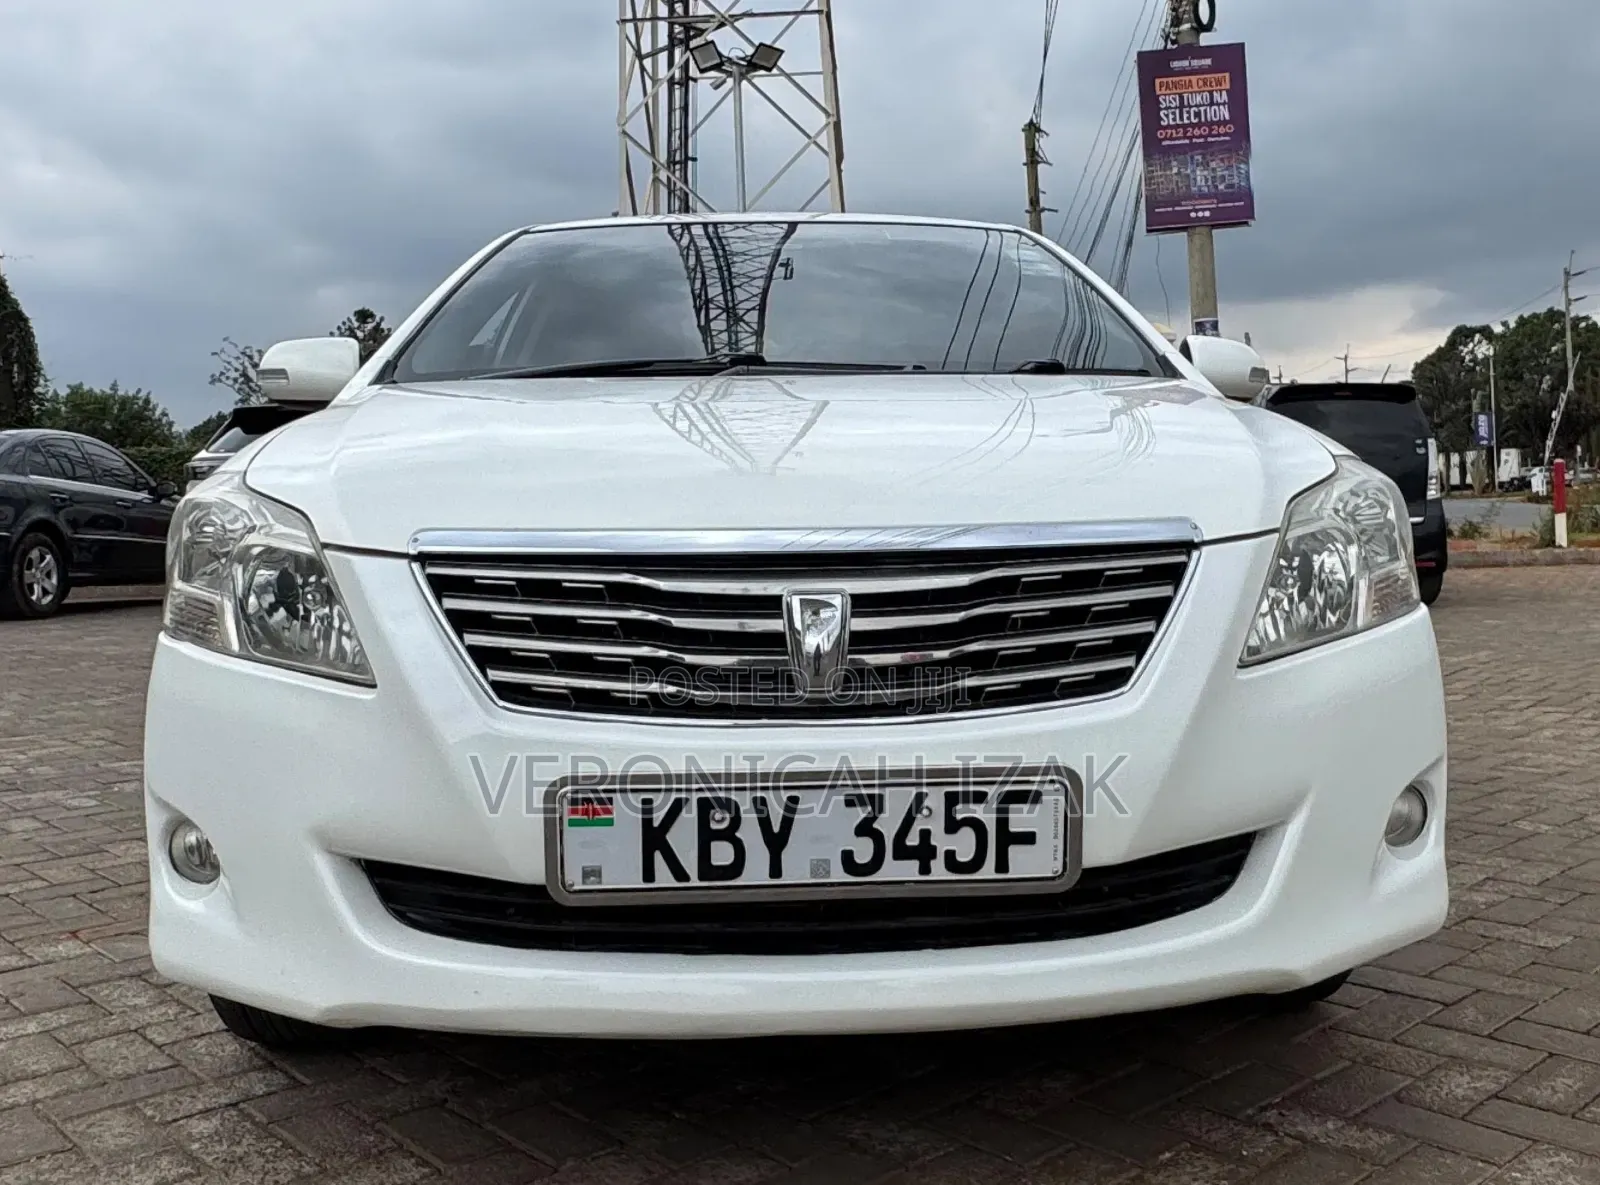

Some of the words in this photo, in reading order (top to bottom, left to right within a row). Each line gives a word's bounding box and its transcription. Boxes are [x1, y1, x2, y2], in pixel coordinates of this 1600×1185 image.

[1159, 93, 1180, 108] SISI
[1182, 91, 1210, 106] TUKO
[1213, 89, 1229, 104] NA
[1160, 104, 1230, 126] SELECTION
[1157, 127, 1184, 139] 0712
[1186, 126, 1209, 137] 260
[1211, 123, 1234, 135] 260
[641, 795, 801, 884] KBY
[840, 788, 1043, 877] 345F
